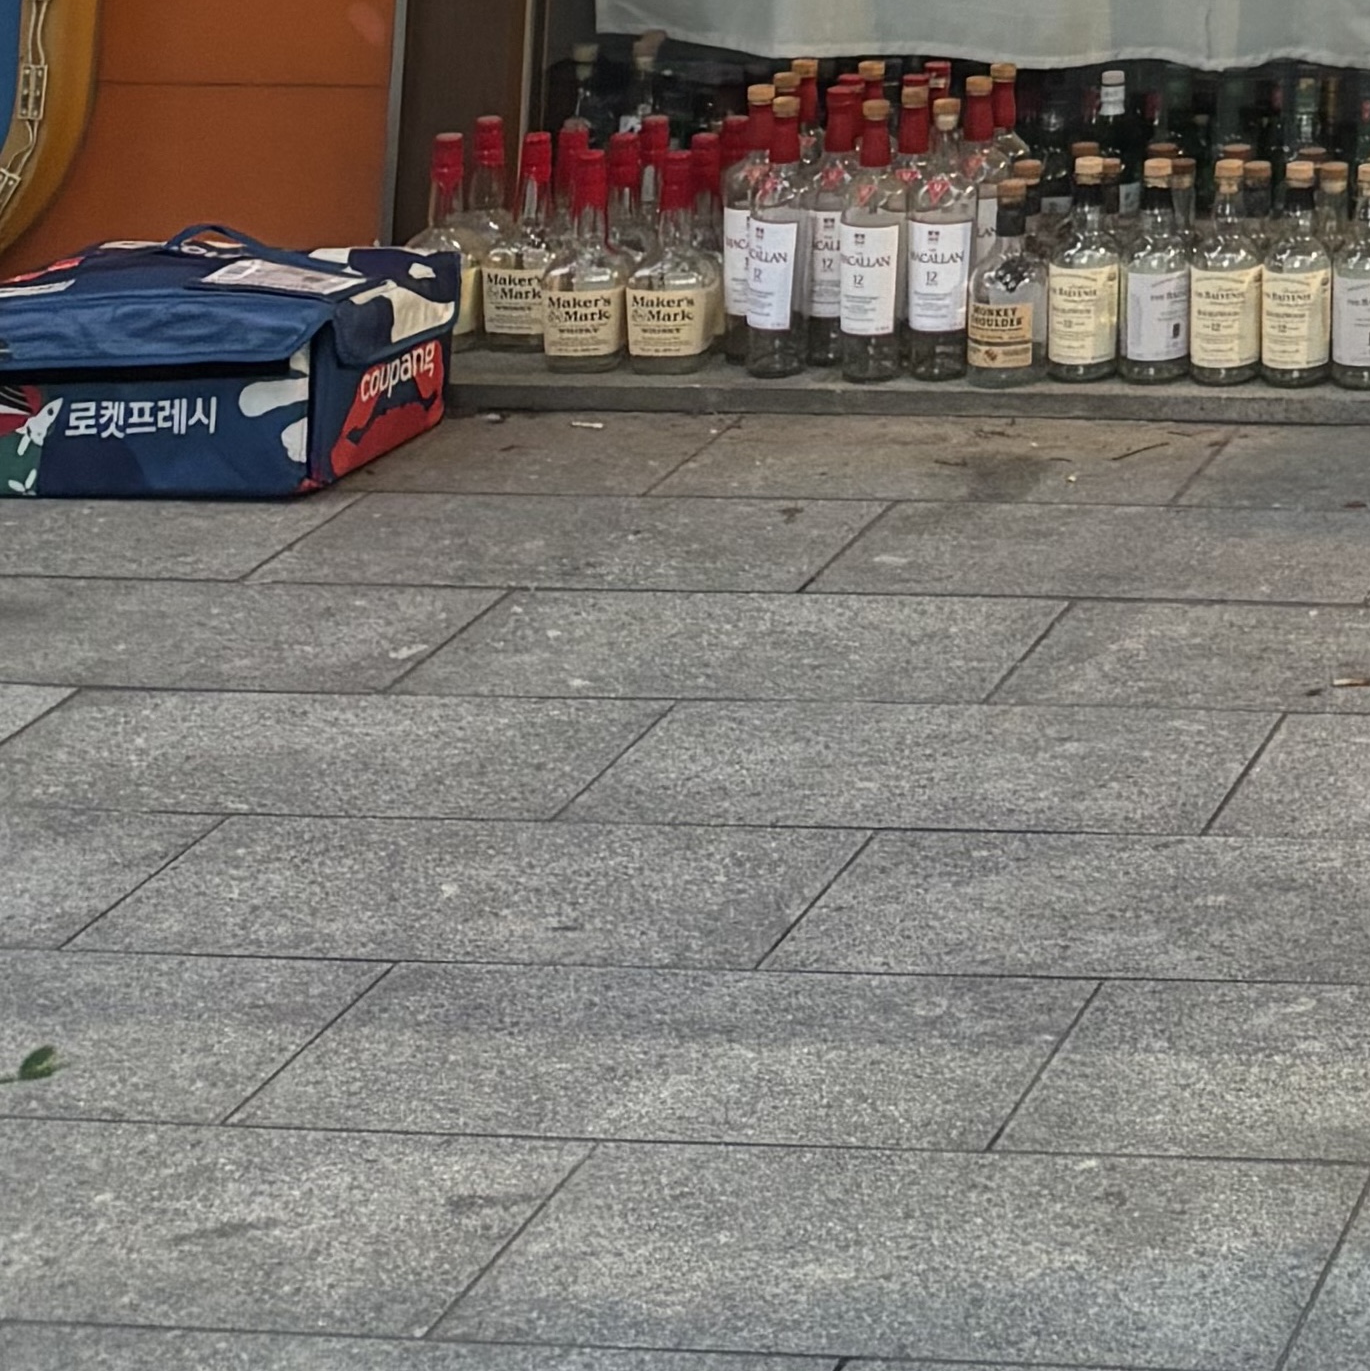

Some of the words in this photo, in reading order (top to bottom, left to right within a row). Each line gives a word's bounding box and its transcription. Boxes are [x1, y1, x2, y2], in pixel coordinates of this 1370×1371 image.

[500, 287, 542, 301] Mark
[548, 295, 612, 310] Maker's
[631, 295, 695, 310] Maker's
[563, 309, 612, 323] Mark
[646, 309, 694, 323] Mark
[361, 341, 436, 402] coupang
[65, 396, 218, 439] 로켓프레시
